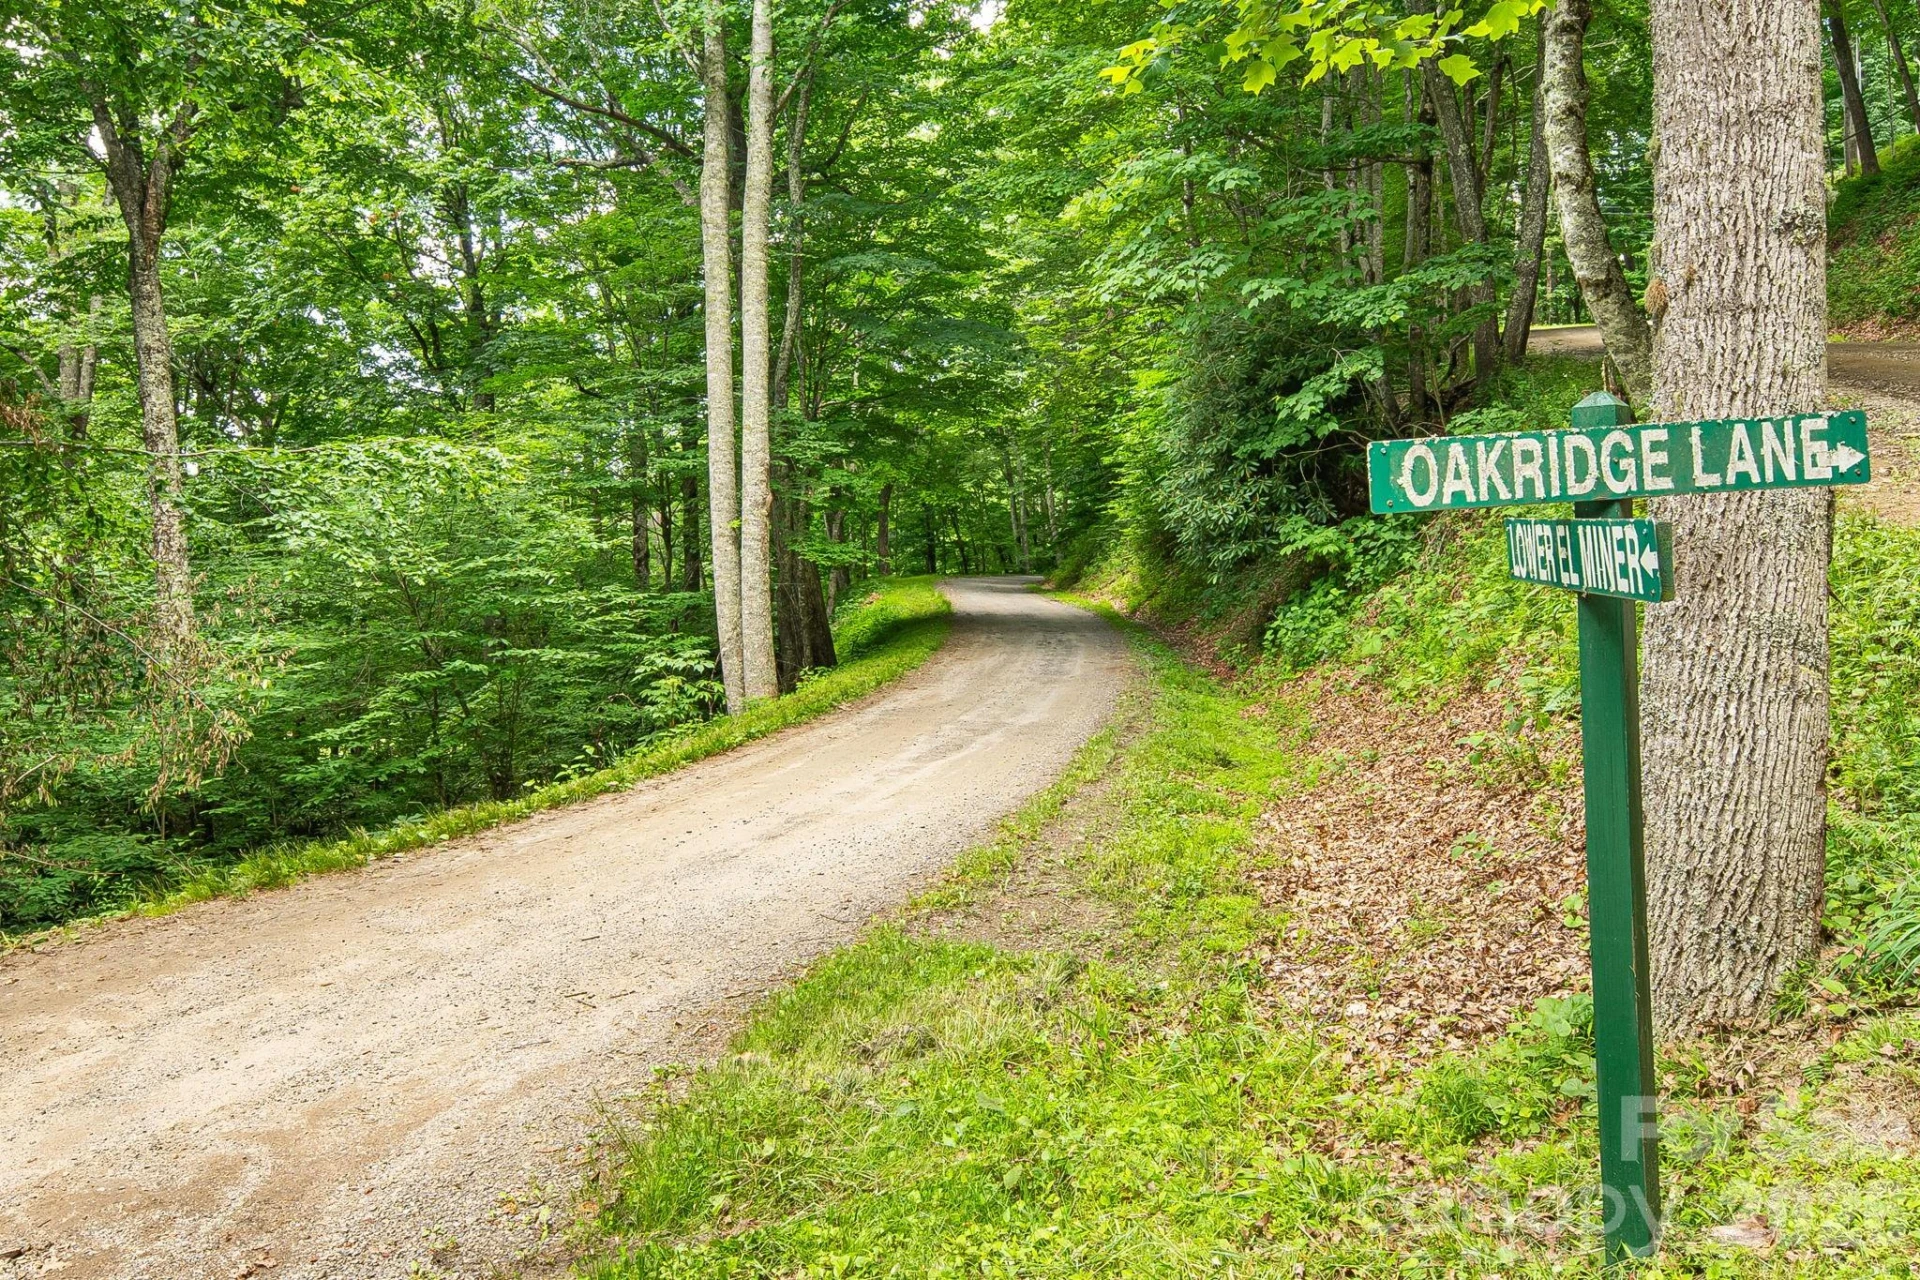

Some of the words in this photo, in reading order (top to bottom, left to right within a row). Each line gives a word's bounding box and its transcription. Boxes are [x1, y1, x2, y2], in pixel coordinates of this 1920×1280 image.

[1400, 428, 1675, 507] OAKRIDGE
[1691, 418, 1834, 489] LANE
[1507, 523, 1557, 582] LOWER
[1556, 525, 1580, 586] EL
[1578, 523, 1644, 594] MINER
